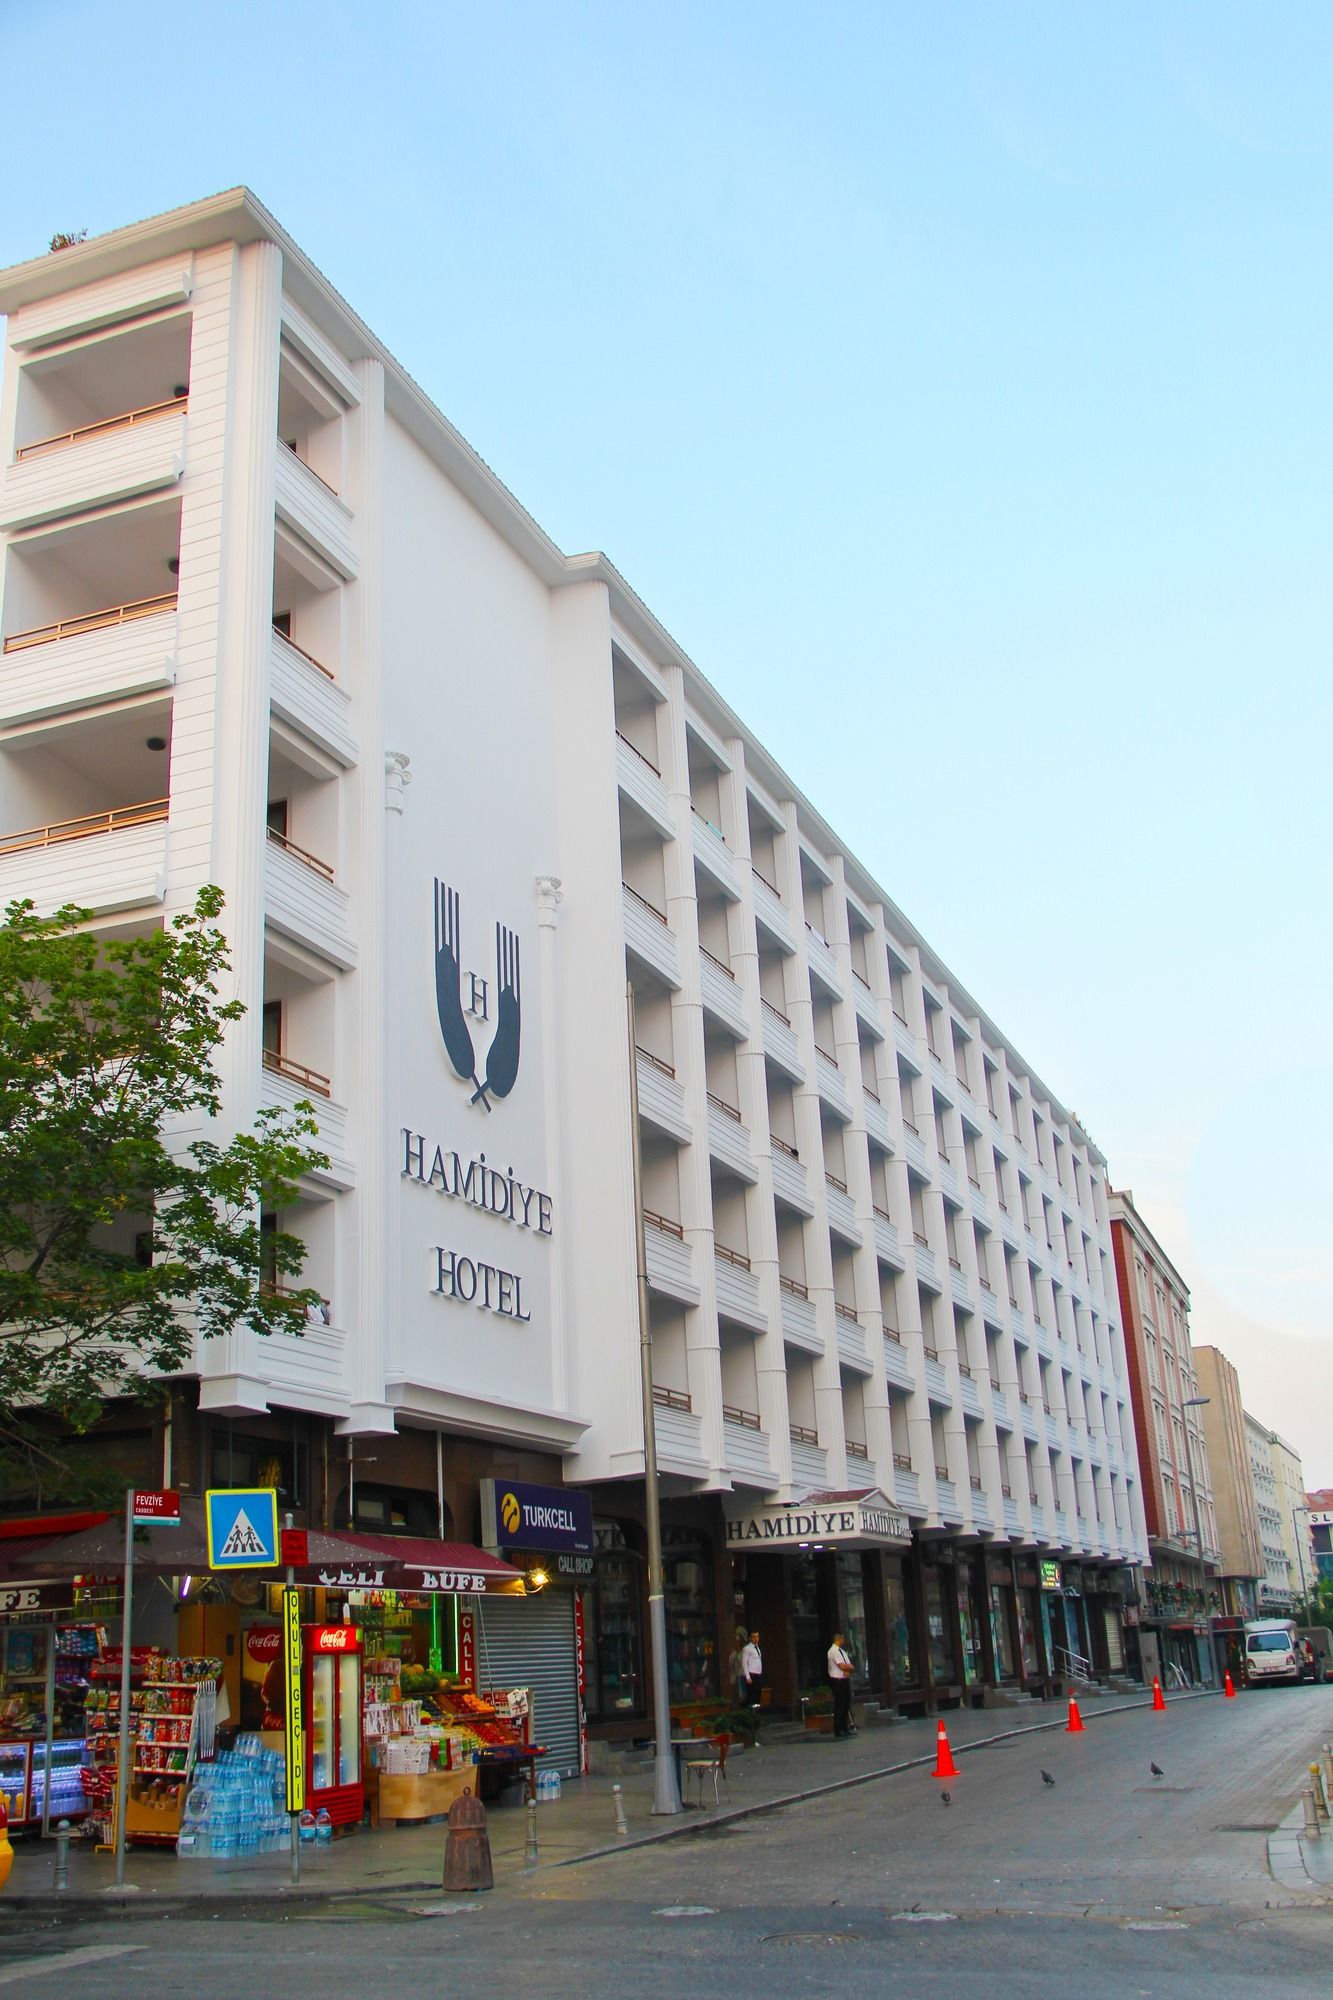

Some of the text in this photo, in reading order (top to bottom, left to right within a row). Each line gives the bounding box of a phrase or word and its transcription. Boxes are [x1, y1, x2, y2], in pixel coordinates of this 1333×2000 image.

[468, 970, 489, 1021] H
[402, 1127, 553, 1236] HAMİDİYE
[435, 1246, 531, 1321] HOTEL
[136, 1494, 163, 1506] FEVZİYE
[523, 1505, 576, 1531] TURKCELL
[727, 1510, 854, 1540] HAMİDİYE
[558, 1555, 575, 1572] CALL
[290, 1595, 298, 1659] OKUL
